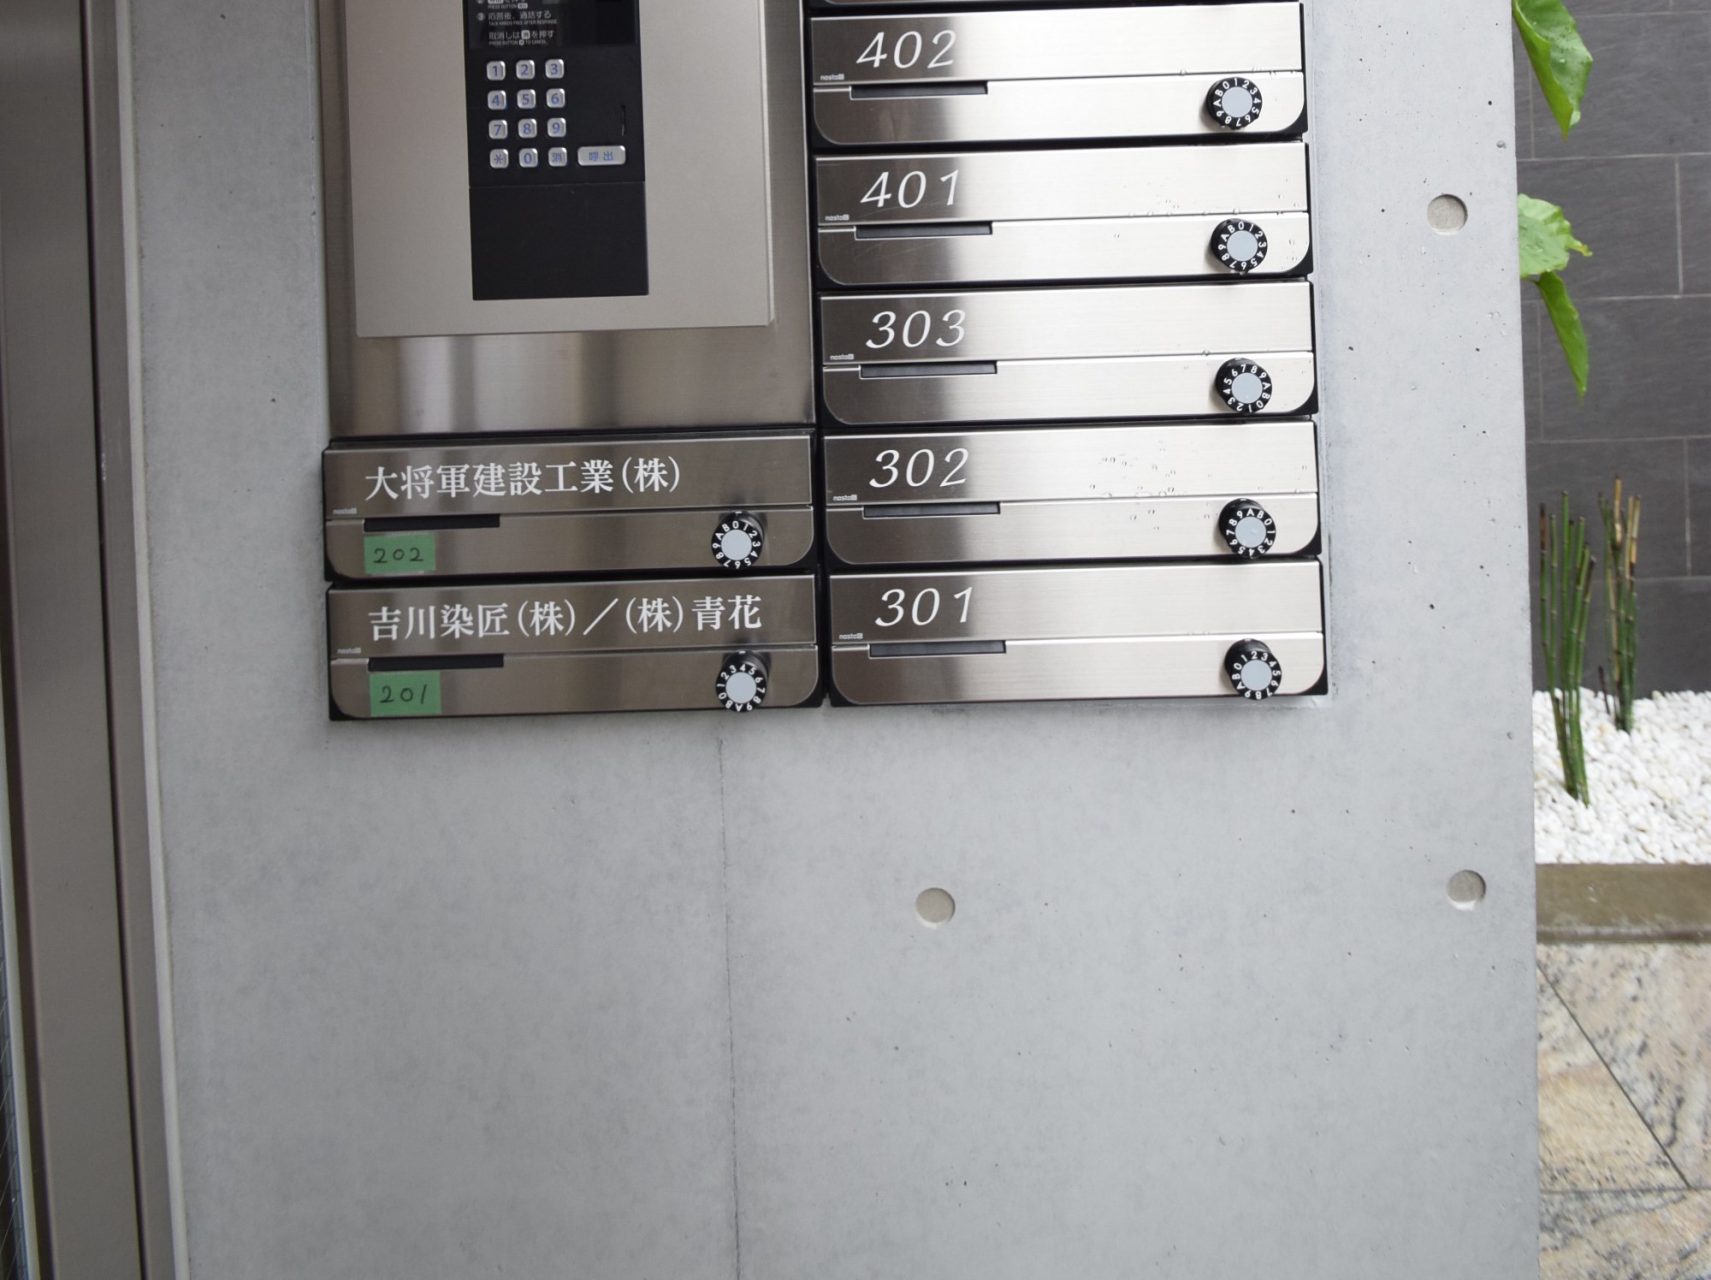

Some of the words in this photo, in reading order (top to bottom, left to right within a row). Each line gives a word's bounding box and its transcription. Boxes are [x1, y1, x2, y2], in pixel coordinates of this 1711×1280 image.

[856, 30, 956, 69] 402
[521, 64, 529, 76] 2
[550, 63, 558, 75] 3
[492, 94, 500, 106] 4
[522, 93, 530, 105] 5
[551, 93, 559, 105] 6
[493, 124, 501, 136] 7
[523, 122, 531, 135] 8
[552, 121, 560, 134] 9
[523, 152, 532, 164] 0
[860, 170, 960, 209] 401
[866, 309, 966, 350] 303
[869, 447, 969, 488] 302
[373, 547, 424, 565] 202
[875, 586, 974, 627] 301
[379, 684, 428, 705] 201
